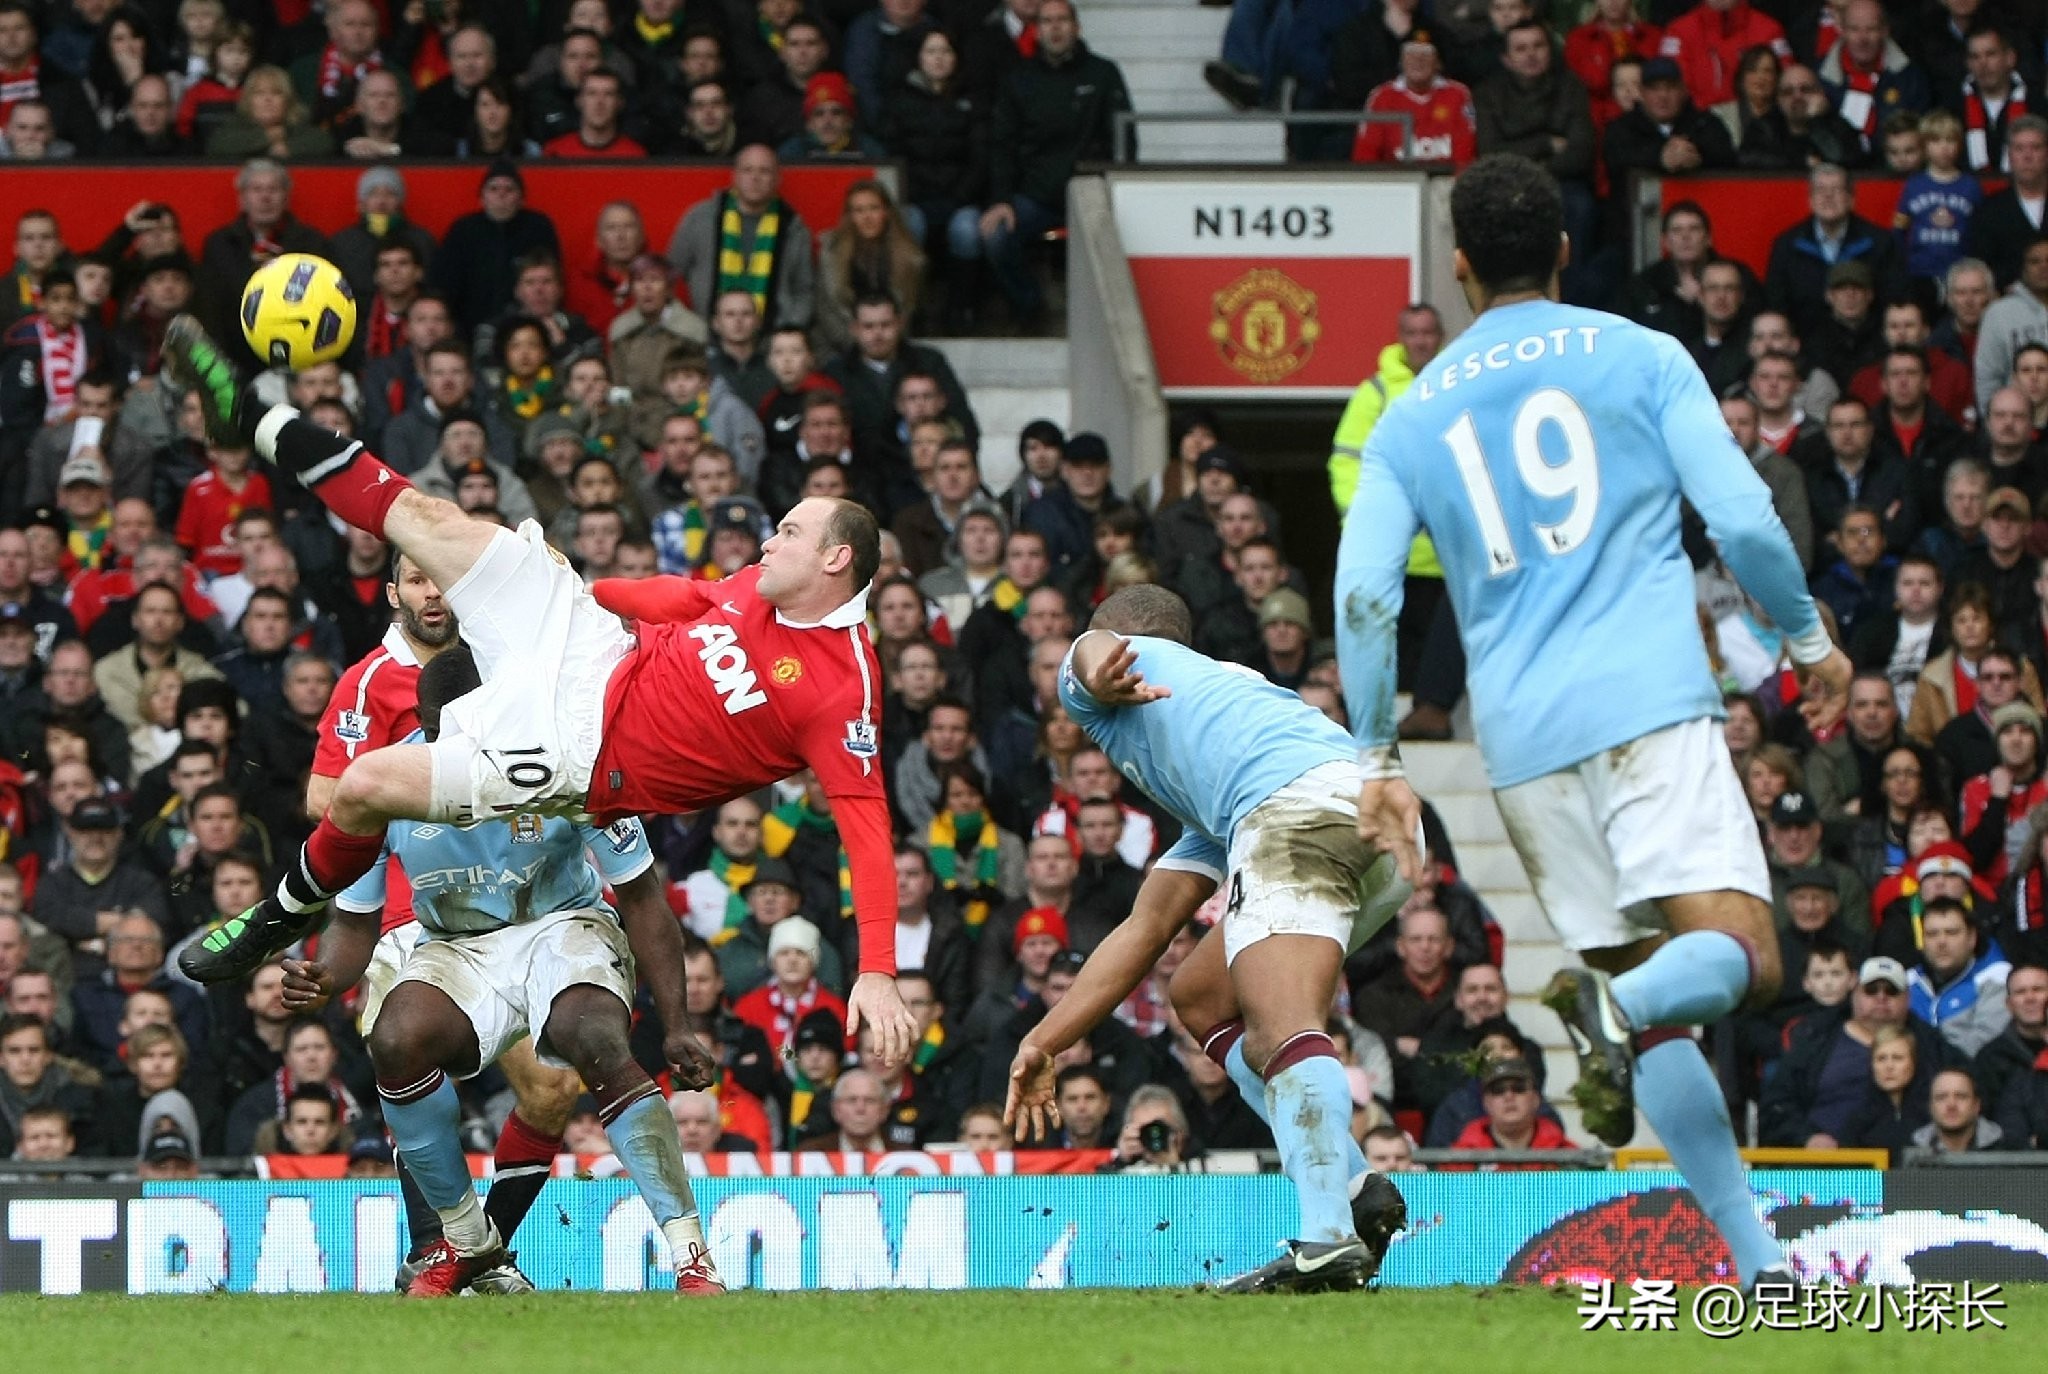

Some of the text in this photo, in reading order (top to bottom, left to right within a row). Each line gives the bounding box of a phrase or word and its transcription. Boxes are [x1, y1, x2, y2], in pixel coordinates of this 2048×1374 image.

[1195, 207, 1334, 237] N1403
[1420, 327, 1601, 401] LESCOTT
[1441, 386, 1600, 577] 19
[688, 624, 768, 716] AON
[498, 743, 552, 788] 10
